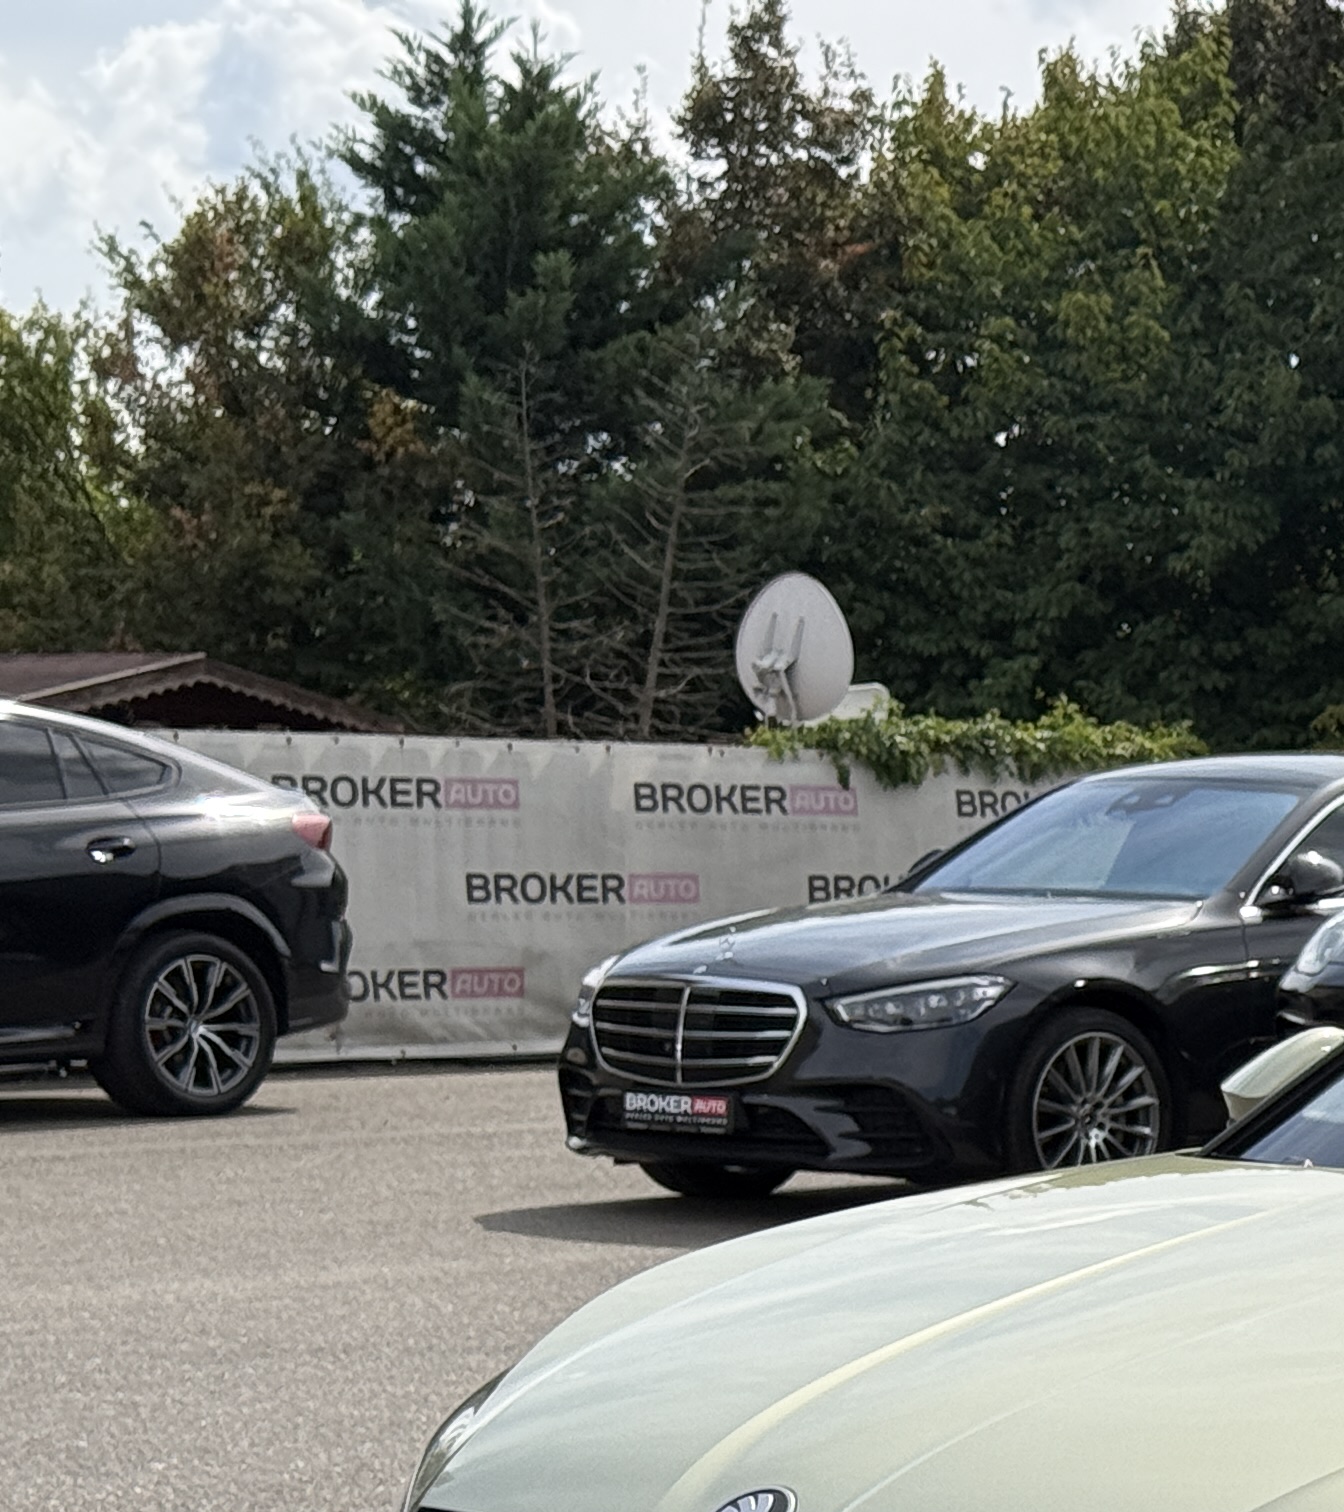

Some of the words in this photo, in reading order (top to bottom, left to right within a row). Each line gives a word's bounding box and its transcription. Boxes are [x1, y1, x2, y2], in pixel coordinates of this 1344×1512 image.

[451, 783, 518, 806] AUTO
[633, 782, 789, 816] BROKER
[793, 790, 856, 812] AUTO
[955, 789, 1031, 818] BRO
[465, 872, 627, 905] BROKER
[631, 878, 698, 899] AUTO
[808, 874, 891, 904] BRO
[455, 972, 522, 994] AUTO
[625, 1092, 693, 1115] BROKER
[693, 1097, 727, 1114] AUTO
